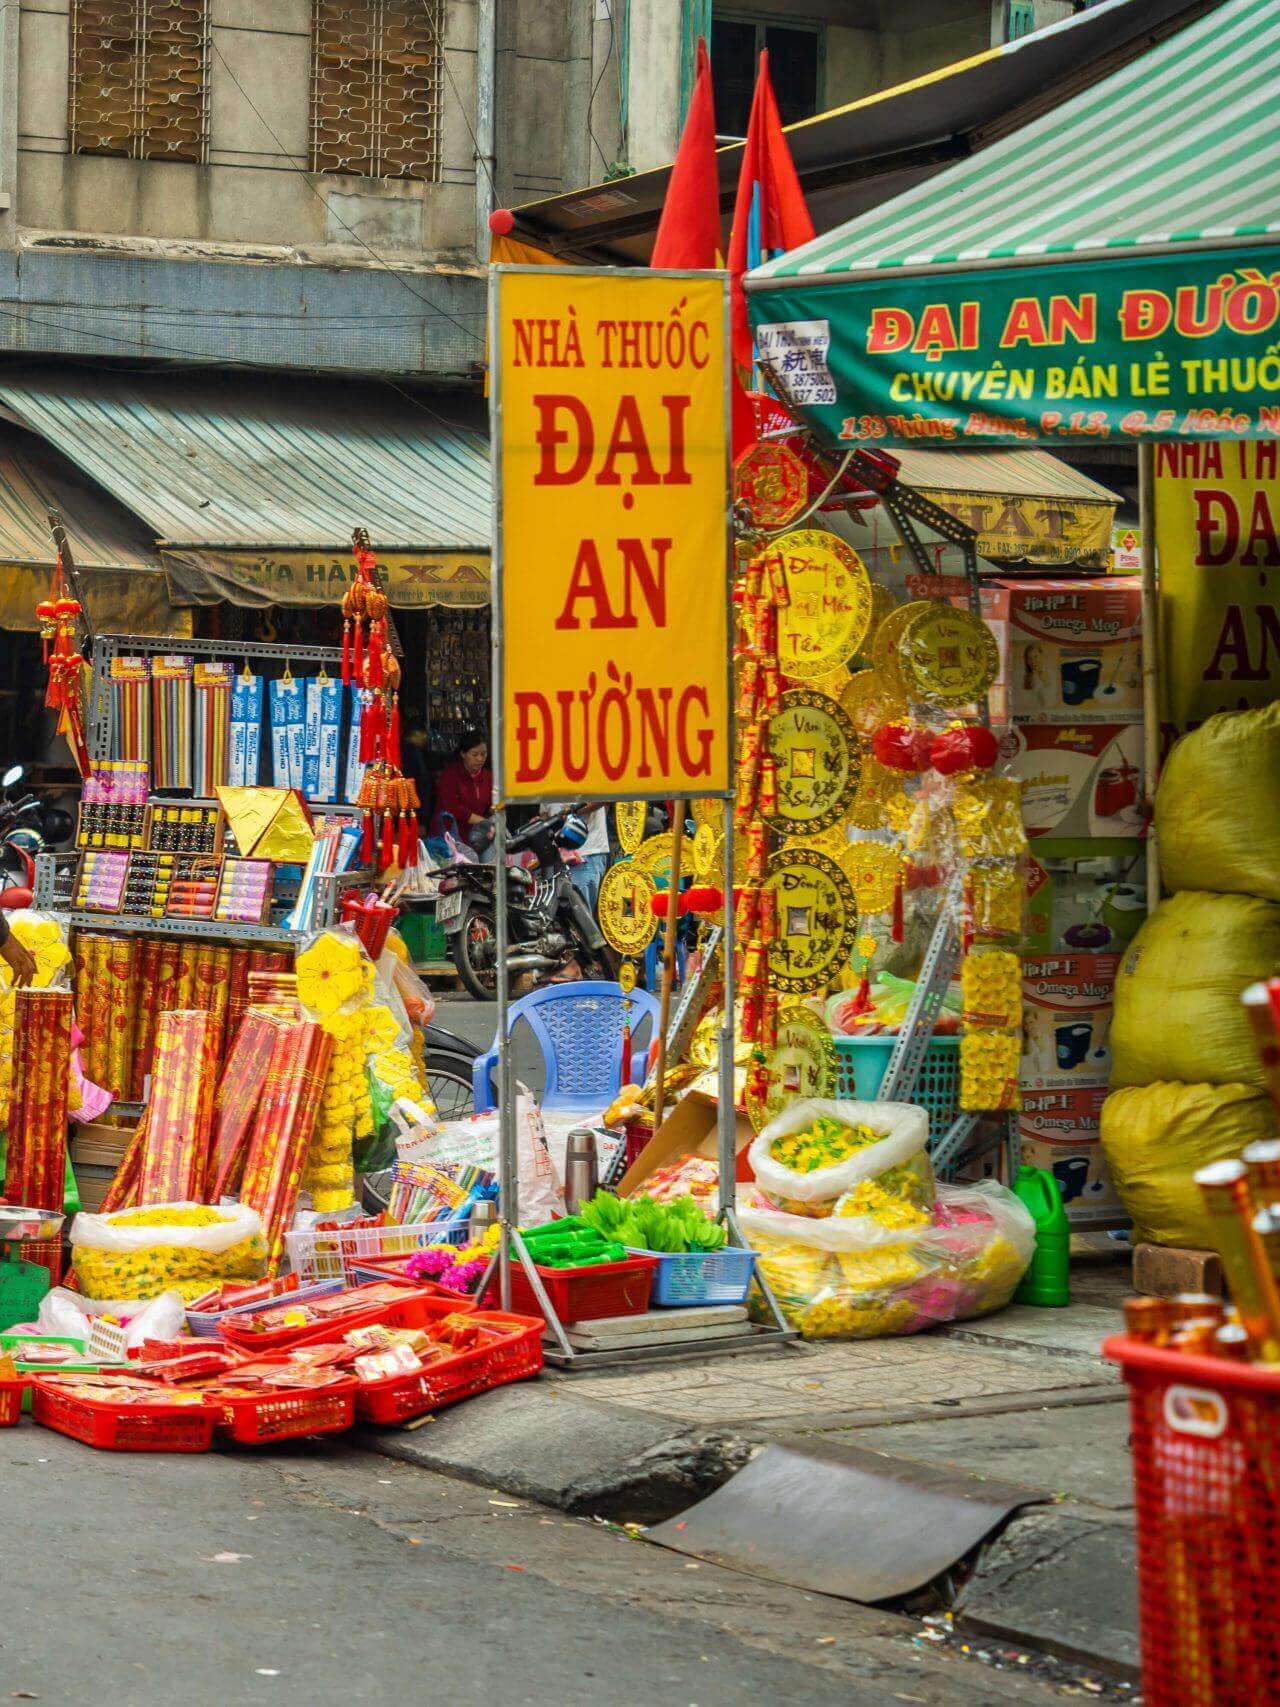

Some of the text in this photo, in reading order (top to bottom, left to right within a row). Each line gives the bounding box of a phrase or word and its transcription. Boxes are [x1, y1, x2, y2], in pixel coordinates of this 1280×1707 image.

[513, 296, 710, 370] NHÀ THUỐC
[867, 302, 979, 361] ĐẠI
[999, 293, 1097, 349] AN
[889, 360, 1035, 402] CHUYÊN
[1046, 356, 1118, 400] BÁN
[1130, 351, 1169, 396] LẺ
[533, 395, 692, 510] ĐẠI
[838, 415, 888, 439] 133
[306, 560, 389, 583] HÀG
[555, 538, 672, 630] AN
[1041, 615, 1121, 636] Omega Mop
[514, 659, 715, 783] ĐƯỜNG
[1036, 980, 1110, 1000] Omega Mop
[1033, 1115, 1100, 1133] Omega Mo
